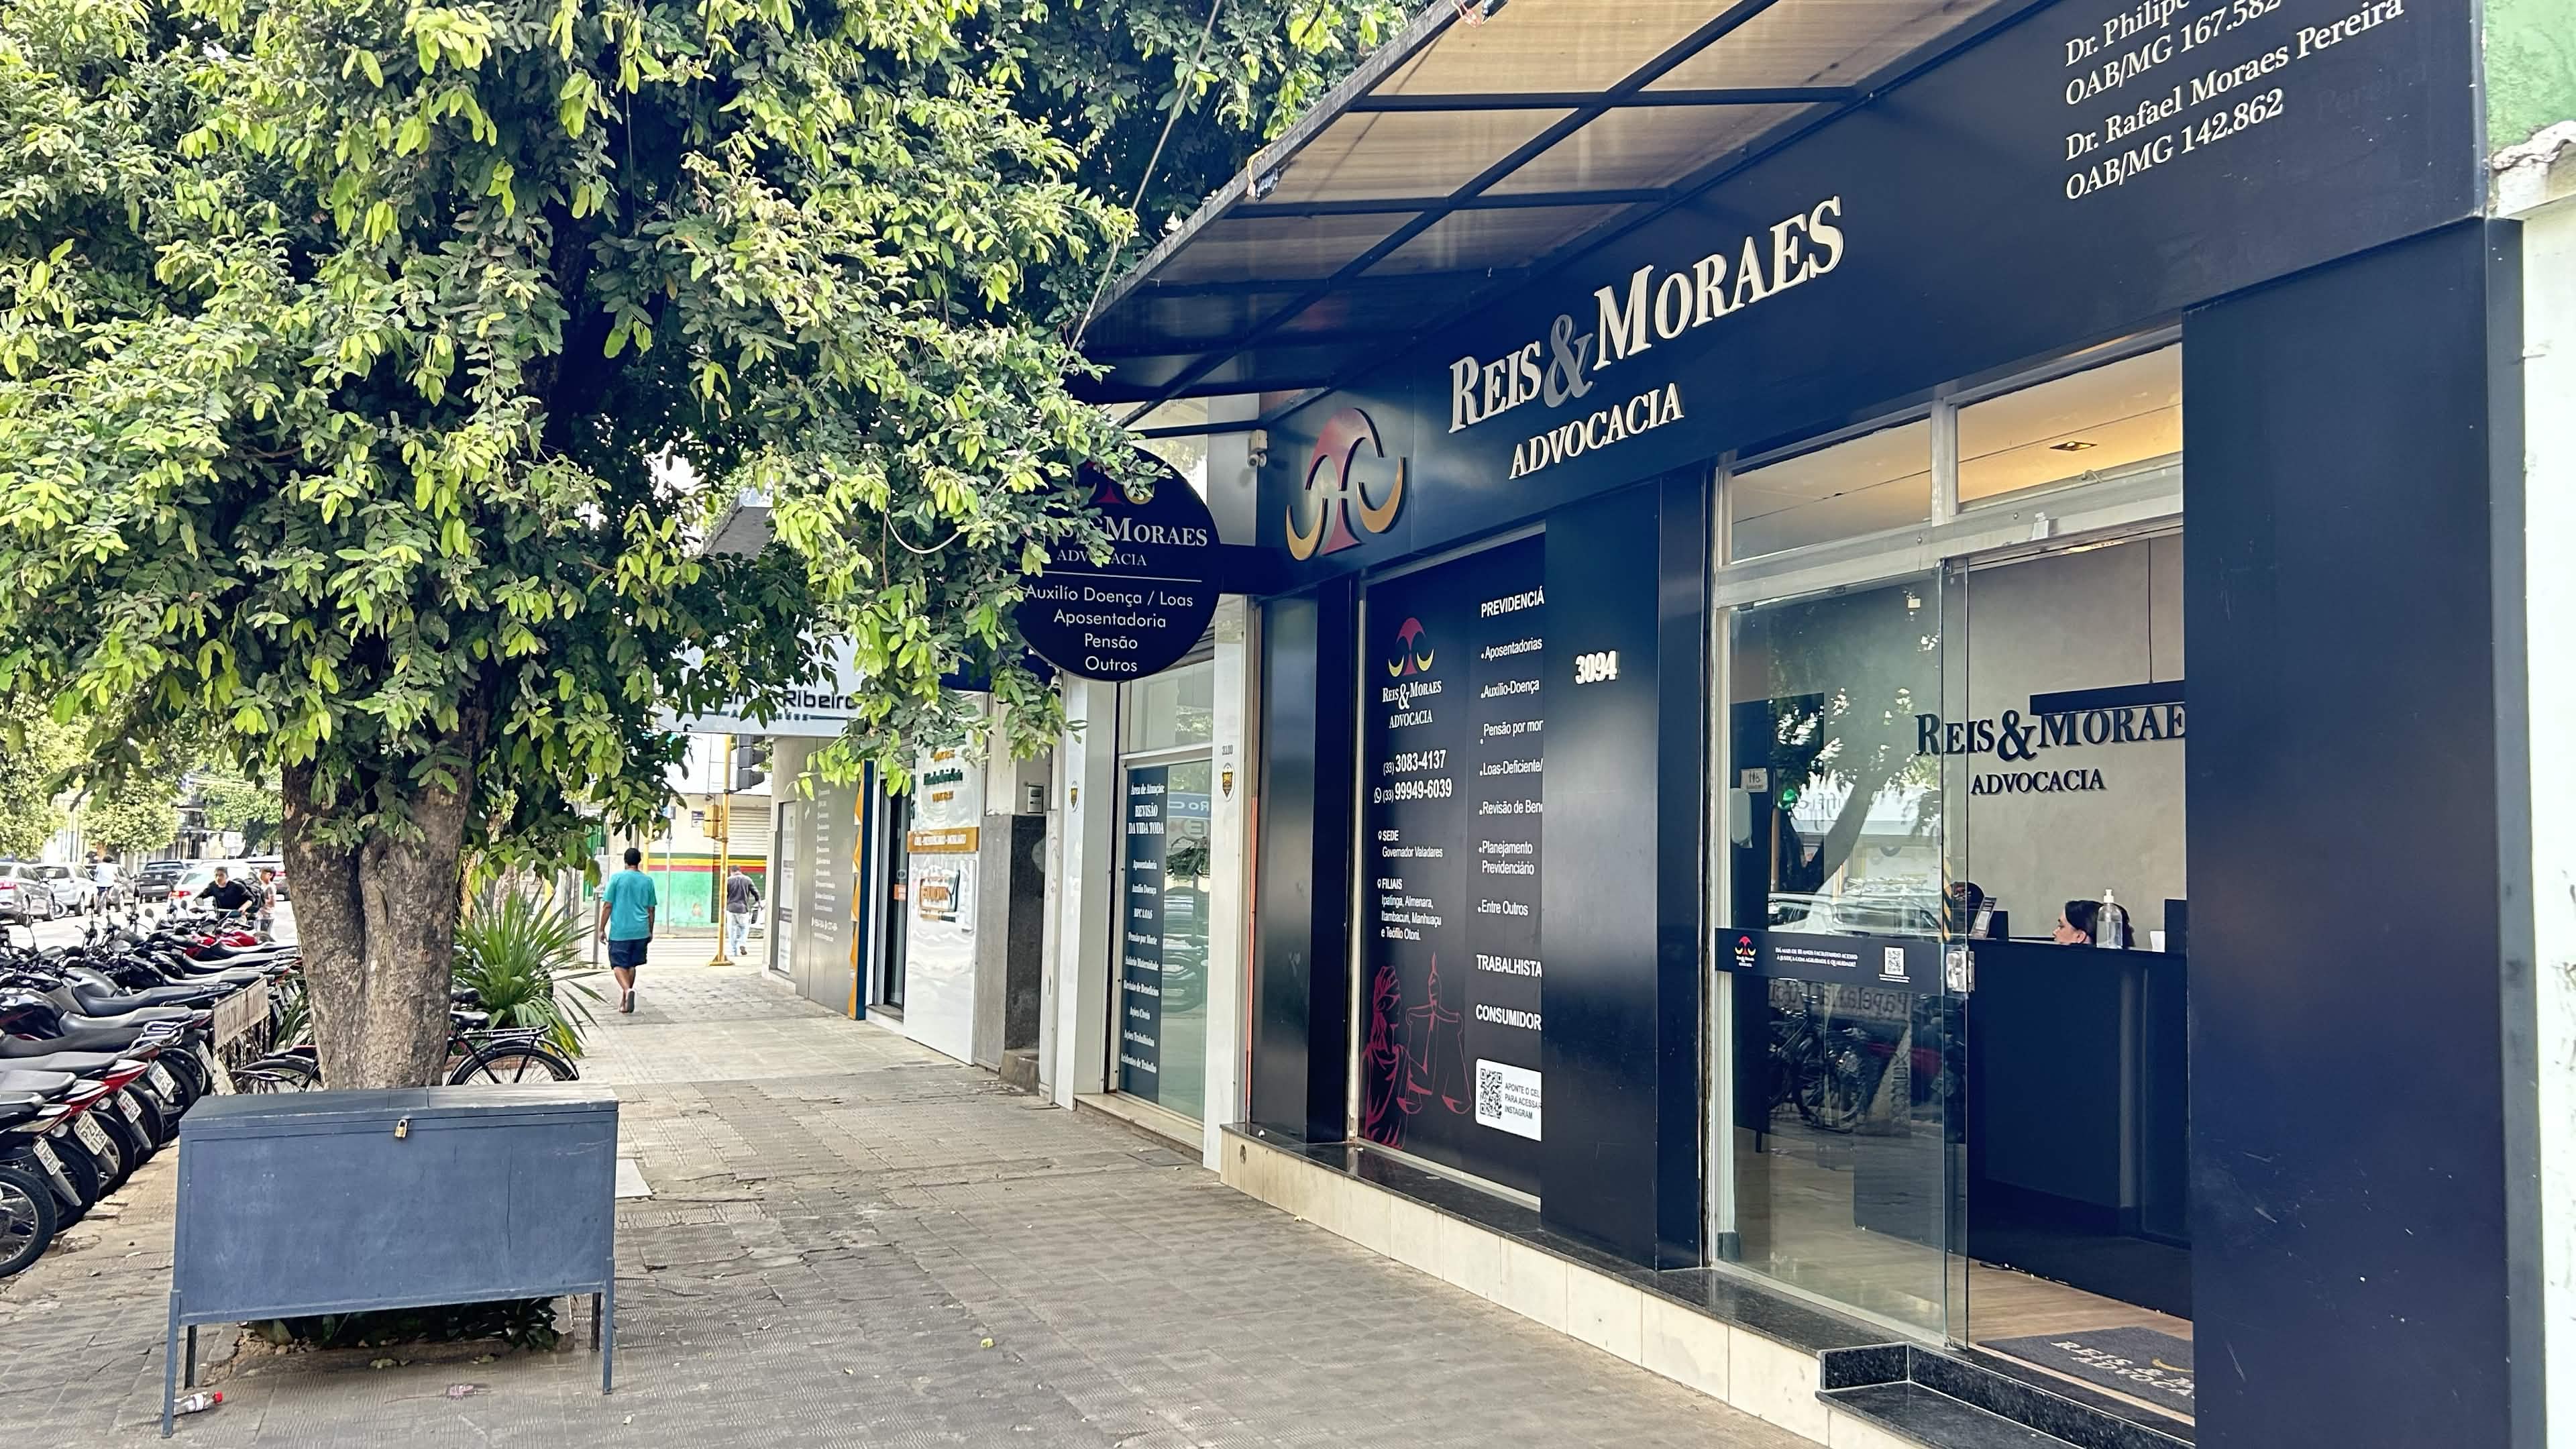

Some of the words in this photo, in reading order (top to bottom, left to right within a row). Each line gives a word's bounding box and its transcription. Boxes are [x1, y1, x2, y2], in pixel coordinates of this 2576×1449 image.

[2065, 36, 2098, 67] Dr.
[2065, 34, 2174, 105] OAB/MG
[2065, 132, 2098, 161] Dr.
[2105, 86, 2183, 144] Rafael
[2190, 46, 2289, 106] Moraes
[2297, 0, 2404, 59] Pereira
[2065, 134, 2174, 200] OAB/MG
[2182, 88, 2284, 154] 142.862
[1593, 195, 1846, 371] MORAES
[1509, 383, 1684, 480] ADVOCACIA
[1104, 516, 1208, 547] MORAES
[1057, 549, 1147, 566] ADVACIA
[1084, 587, 1142, 607] Doença
[1161, 591, 1193, 607] Loas
[1481, 585, 1544, 618] PREVIDENCIÁ
[1053, 608, 1167, 629] Aposentadoria
[1084, 633, 1138, 650] Pensão
[1484, 637, 1543, 661] Aposentadorias
[1085, 655, 1138, 672] Outros
[1574, 650, 1618, 684] 3094
[1389, 709, 1433, 729] ADVOCACIA
[1483, 721, 1511, 737] Pensão
[1512, 722, 1526, 737] por
[1383, 761, 1395, 776] (33)
[1395, 749, 1446, 773] 3083-4137
[1383, 789, 1394, 804] (33)
[1395, 777, 1452, 801] 99949-6039
[1970, 768, 2105, 796] ADVOCACIA
[1134, 802, 1159, 817] REVISÃO
[1483, 800, 1512, 814] Revisão
[1513, 800, 1524, 814] de
[1128, 822, 1136, 834] DA
[1136, 822, 1148, 834] VIDA
[1149, 822, 1165, 834] TODA
[1382, 830, 1399, 841] SEDE
[1382, 846, 1413, 857] Governador
[1414, 846, 1443, 857] Valadares
[1482, 840, 1534, 857] Planejamento
[1482, 859, 1535, 875] Previdenciário
[1382, 878, 1403, 890] FILIAIS
[1405, 896, 1434, 910] Almenara,
[1481, 899, 1501, 914] Entre
[1502, 900, 1529, 916] Outros
[1381, 928, 1385, 937] e
[1476, 954, 1542, 977] TRABALHISTA
[1476, 1004, 1542, 1031] CONSUMIDOR
[1505, 1082, 1524, 1094] APONTE
[1505, 1105, 1533, 1119] INSTAGRAM
